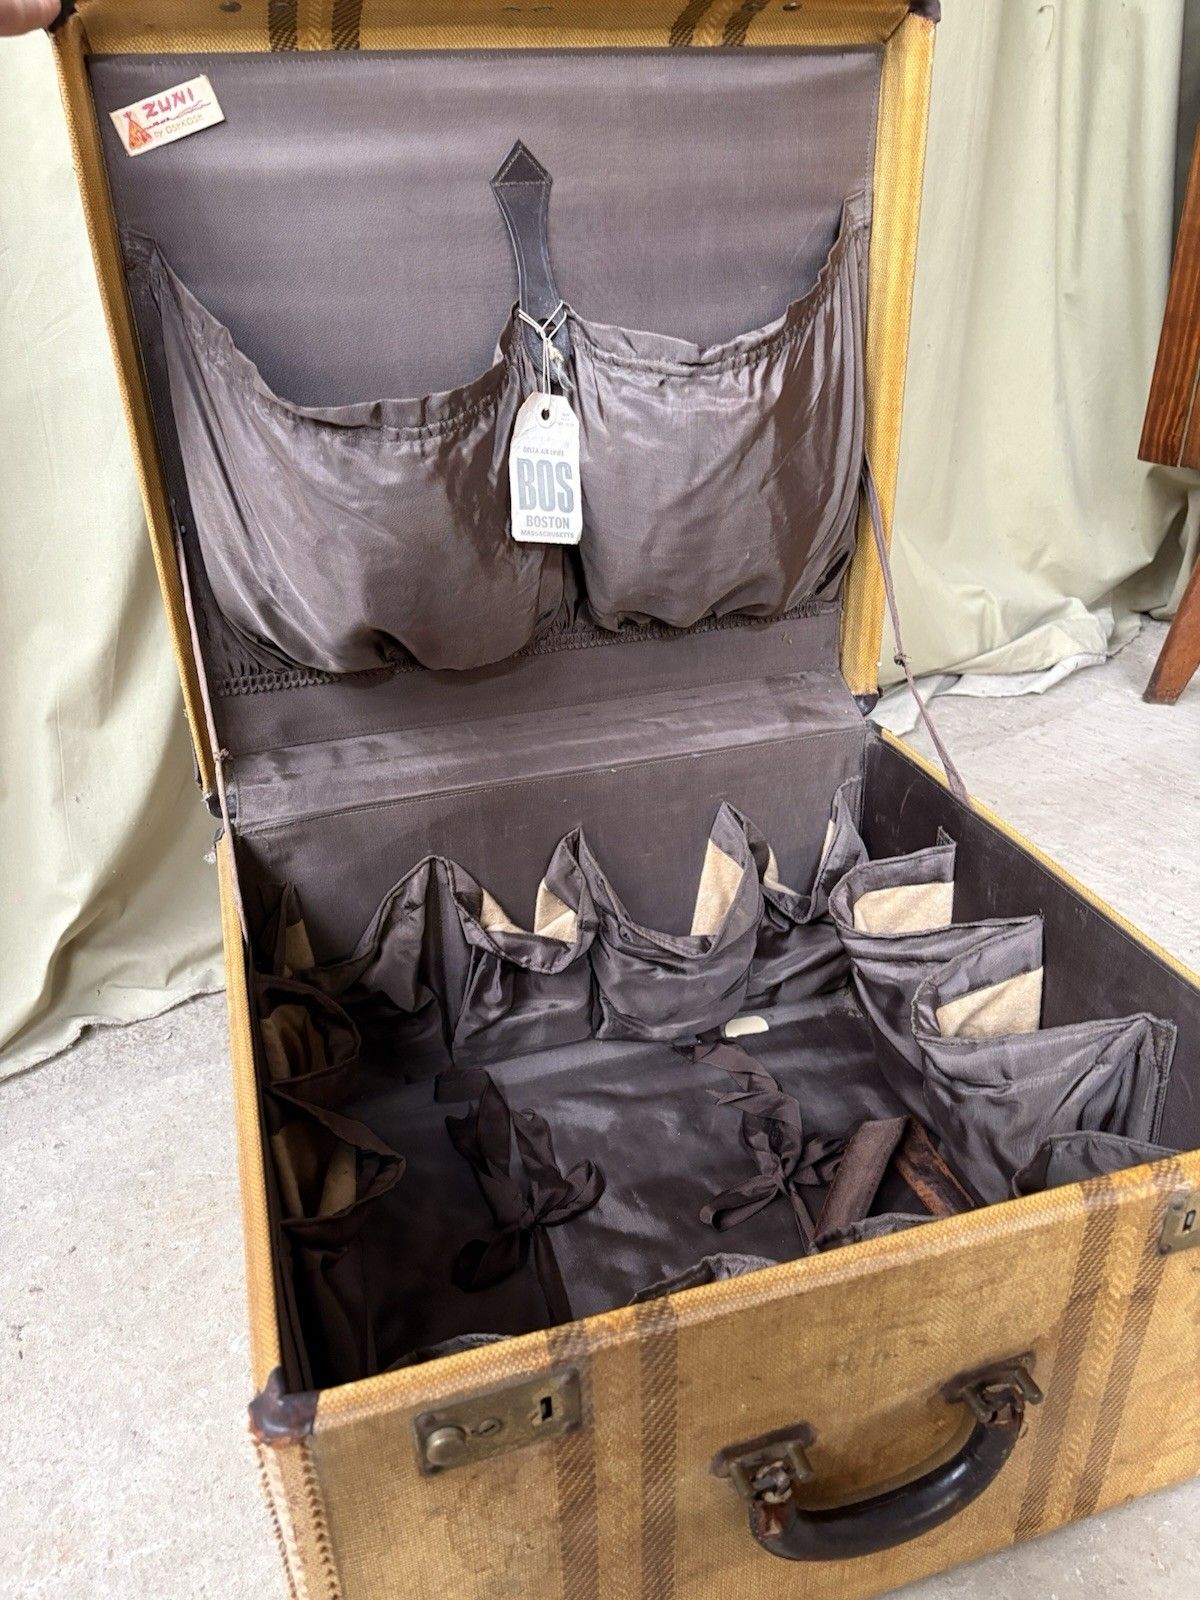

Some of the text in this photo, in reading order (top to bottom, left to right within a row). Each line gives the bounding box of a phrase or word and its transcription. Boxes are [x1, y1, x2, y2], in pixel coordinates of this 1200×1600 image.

[142, 88, 194, 119] ZUNI
[523, 446, 540, 454] DELTA
[517, 458, 574, 514] BOS
[526, 515, 570, 529] BOSTON
[521, 530, 574, 539] MASSACHUSETTS
